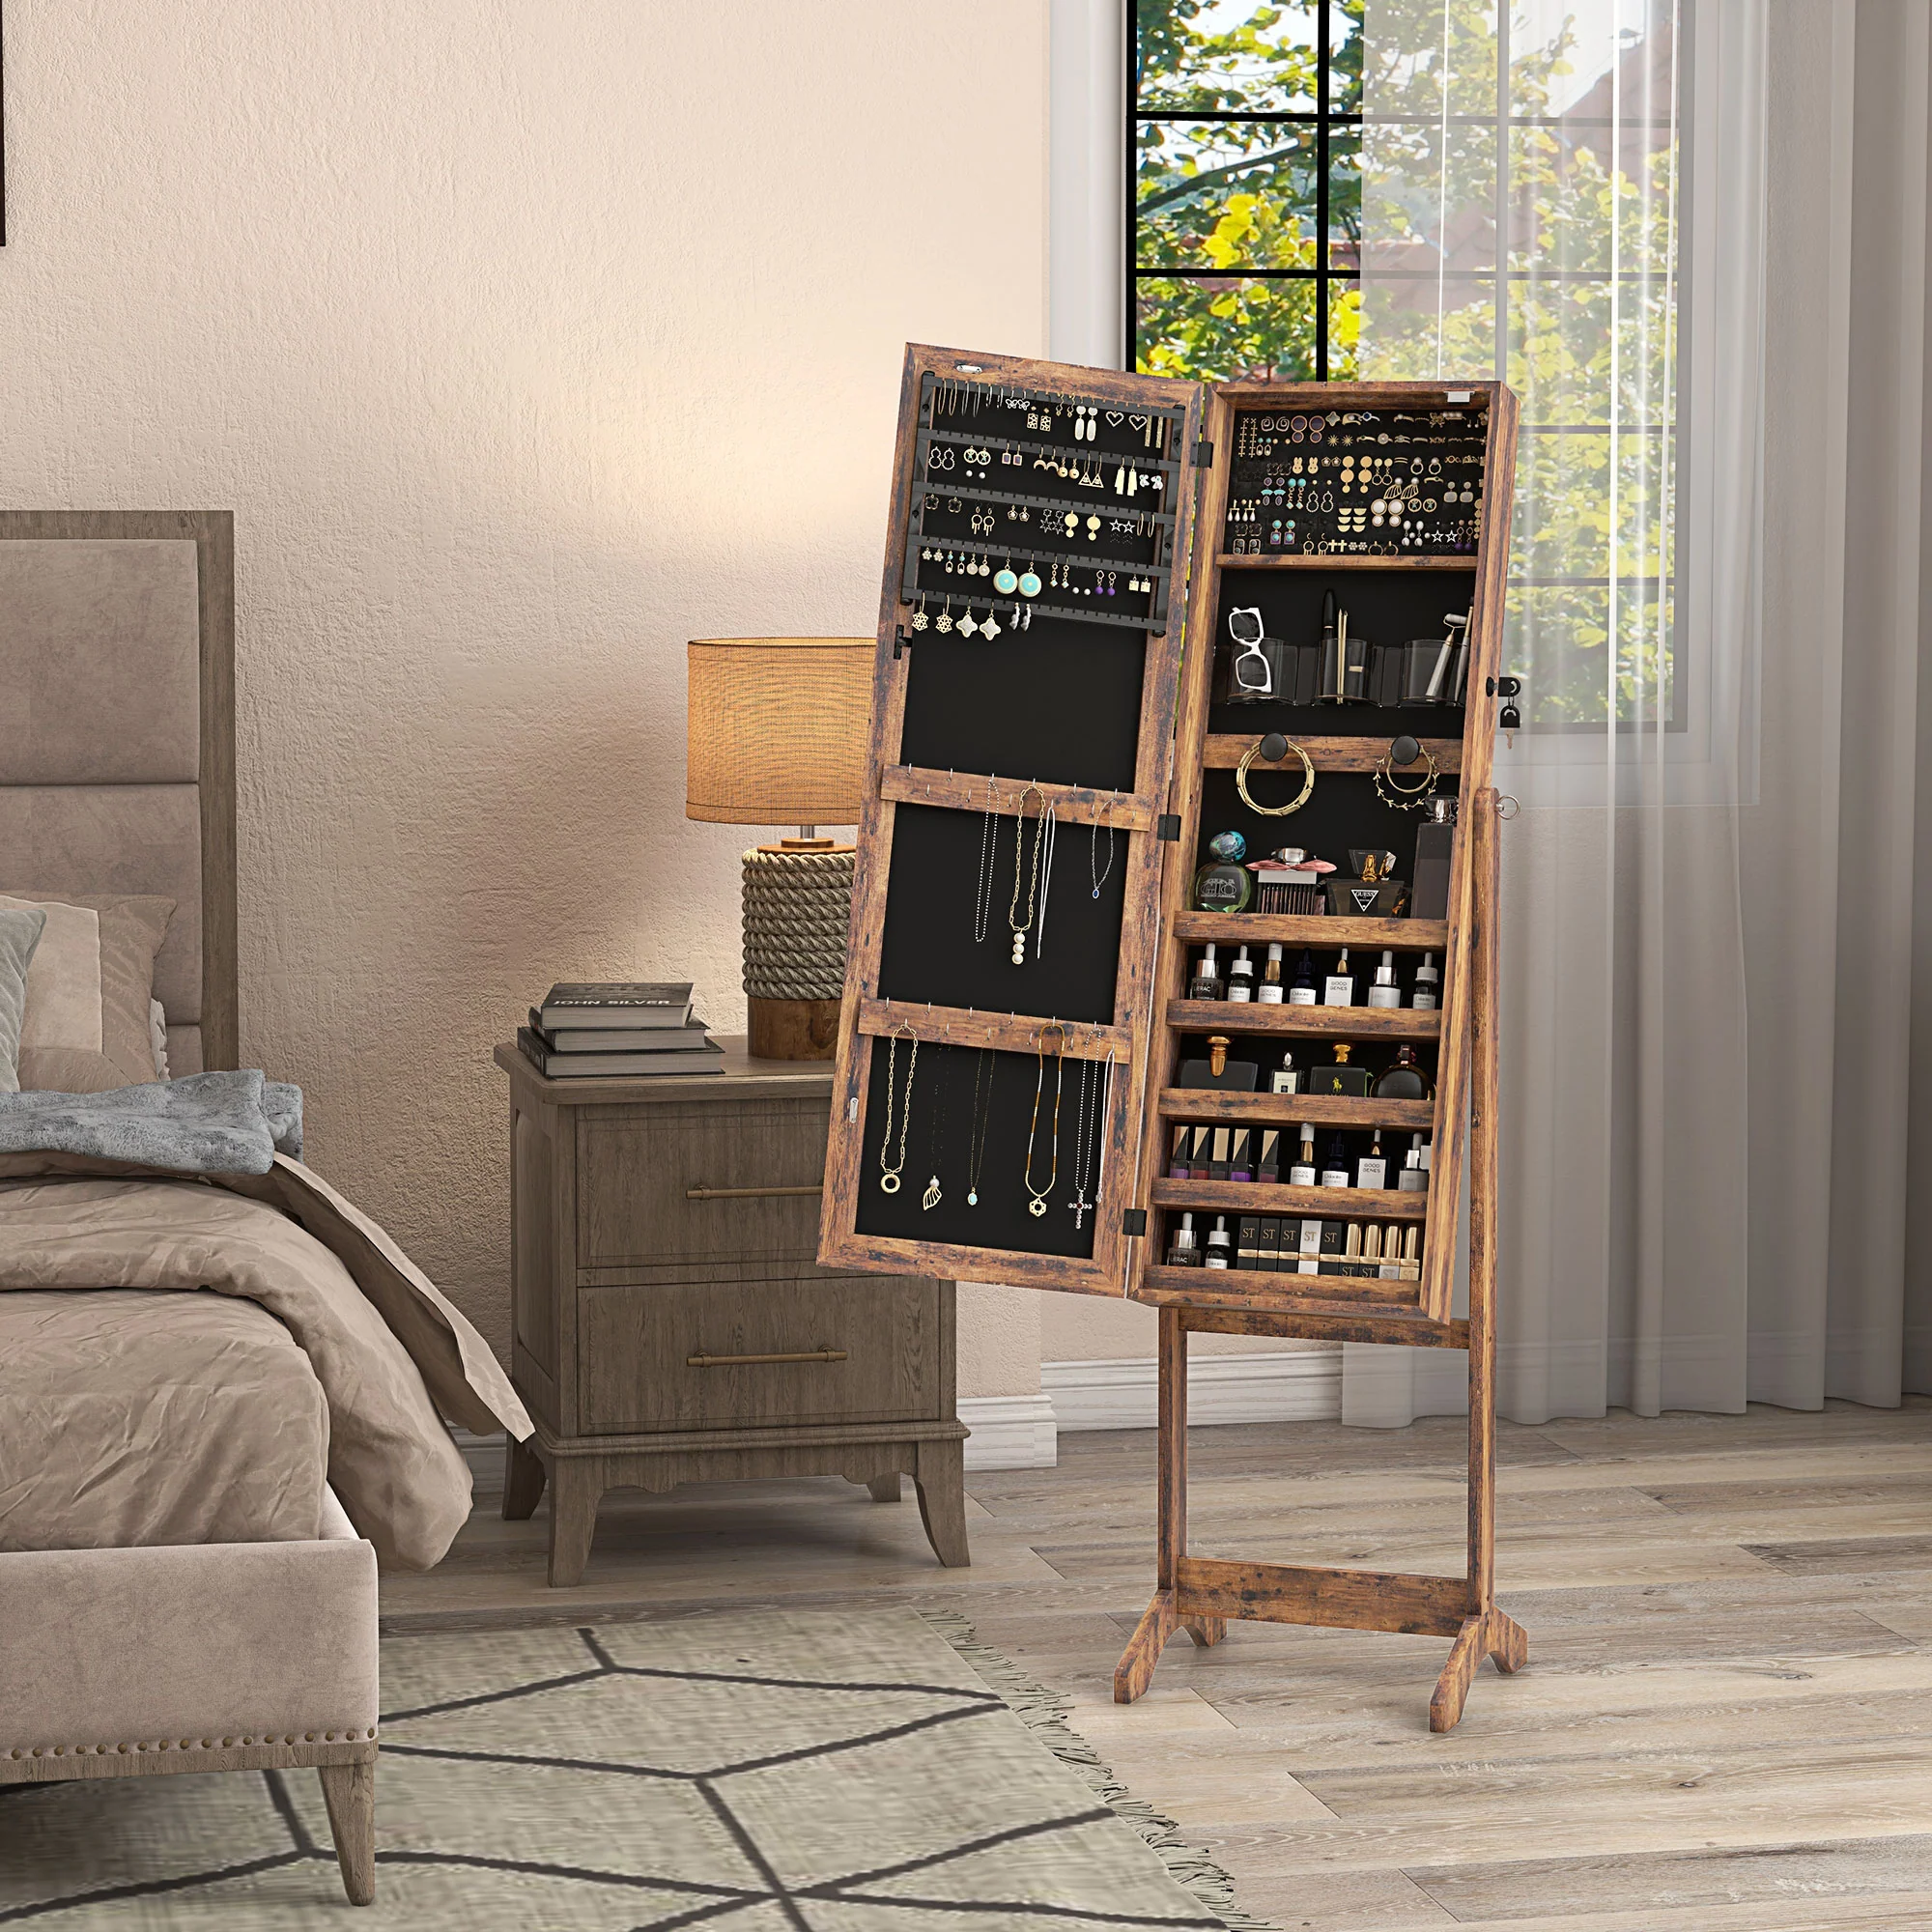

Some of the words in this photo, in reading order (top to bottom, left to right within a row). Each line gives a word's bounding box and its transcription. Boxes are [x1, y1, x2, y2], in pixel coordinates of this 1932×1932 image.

[1242, 1227, 1255, 1238] ST
[1263, 1229, 1275, 1239] ST
[1283, 1230, 1295, 1240] ST
[1303, 1231, 1317, 1241] ST
[1324, 1232, 1337, 1243] ST
[1342, 1265, 1354, 1277] ST
[1361, 1267, 1375, 1278] ST
